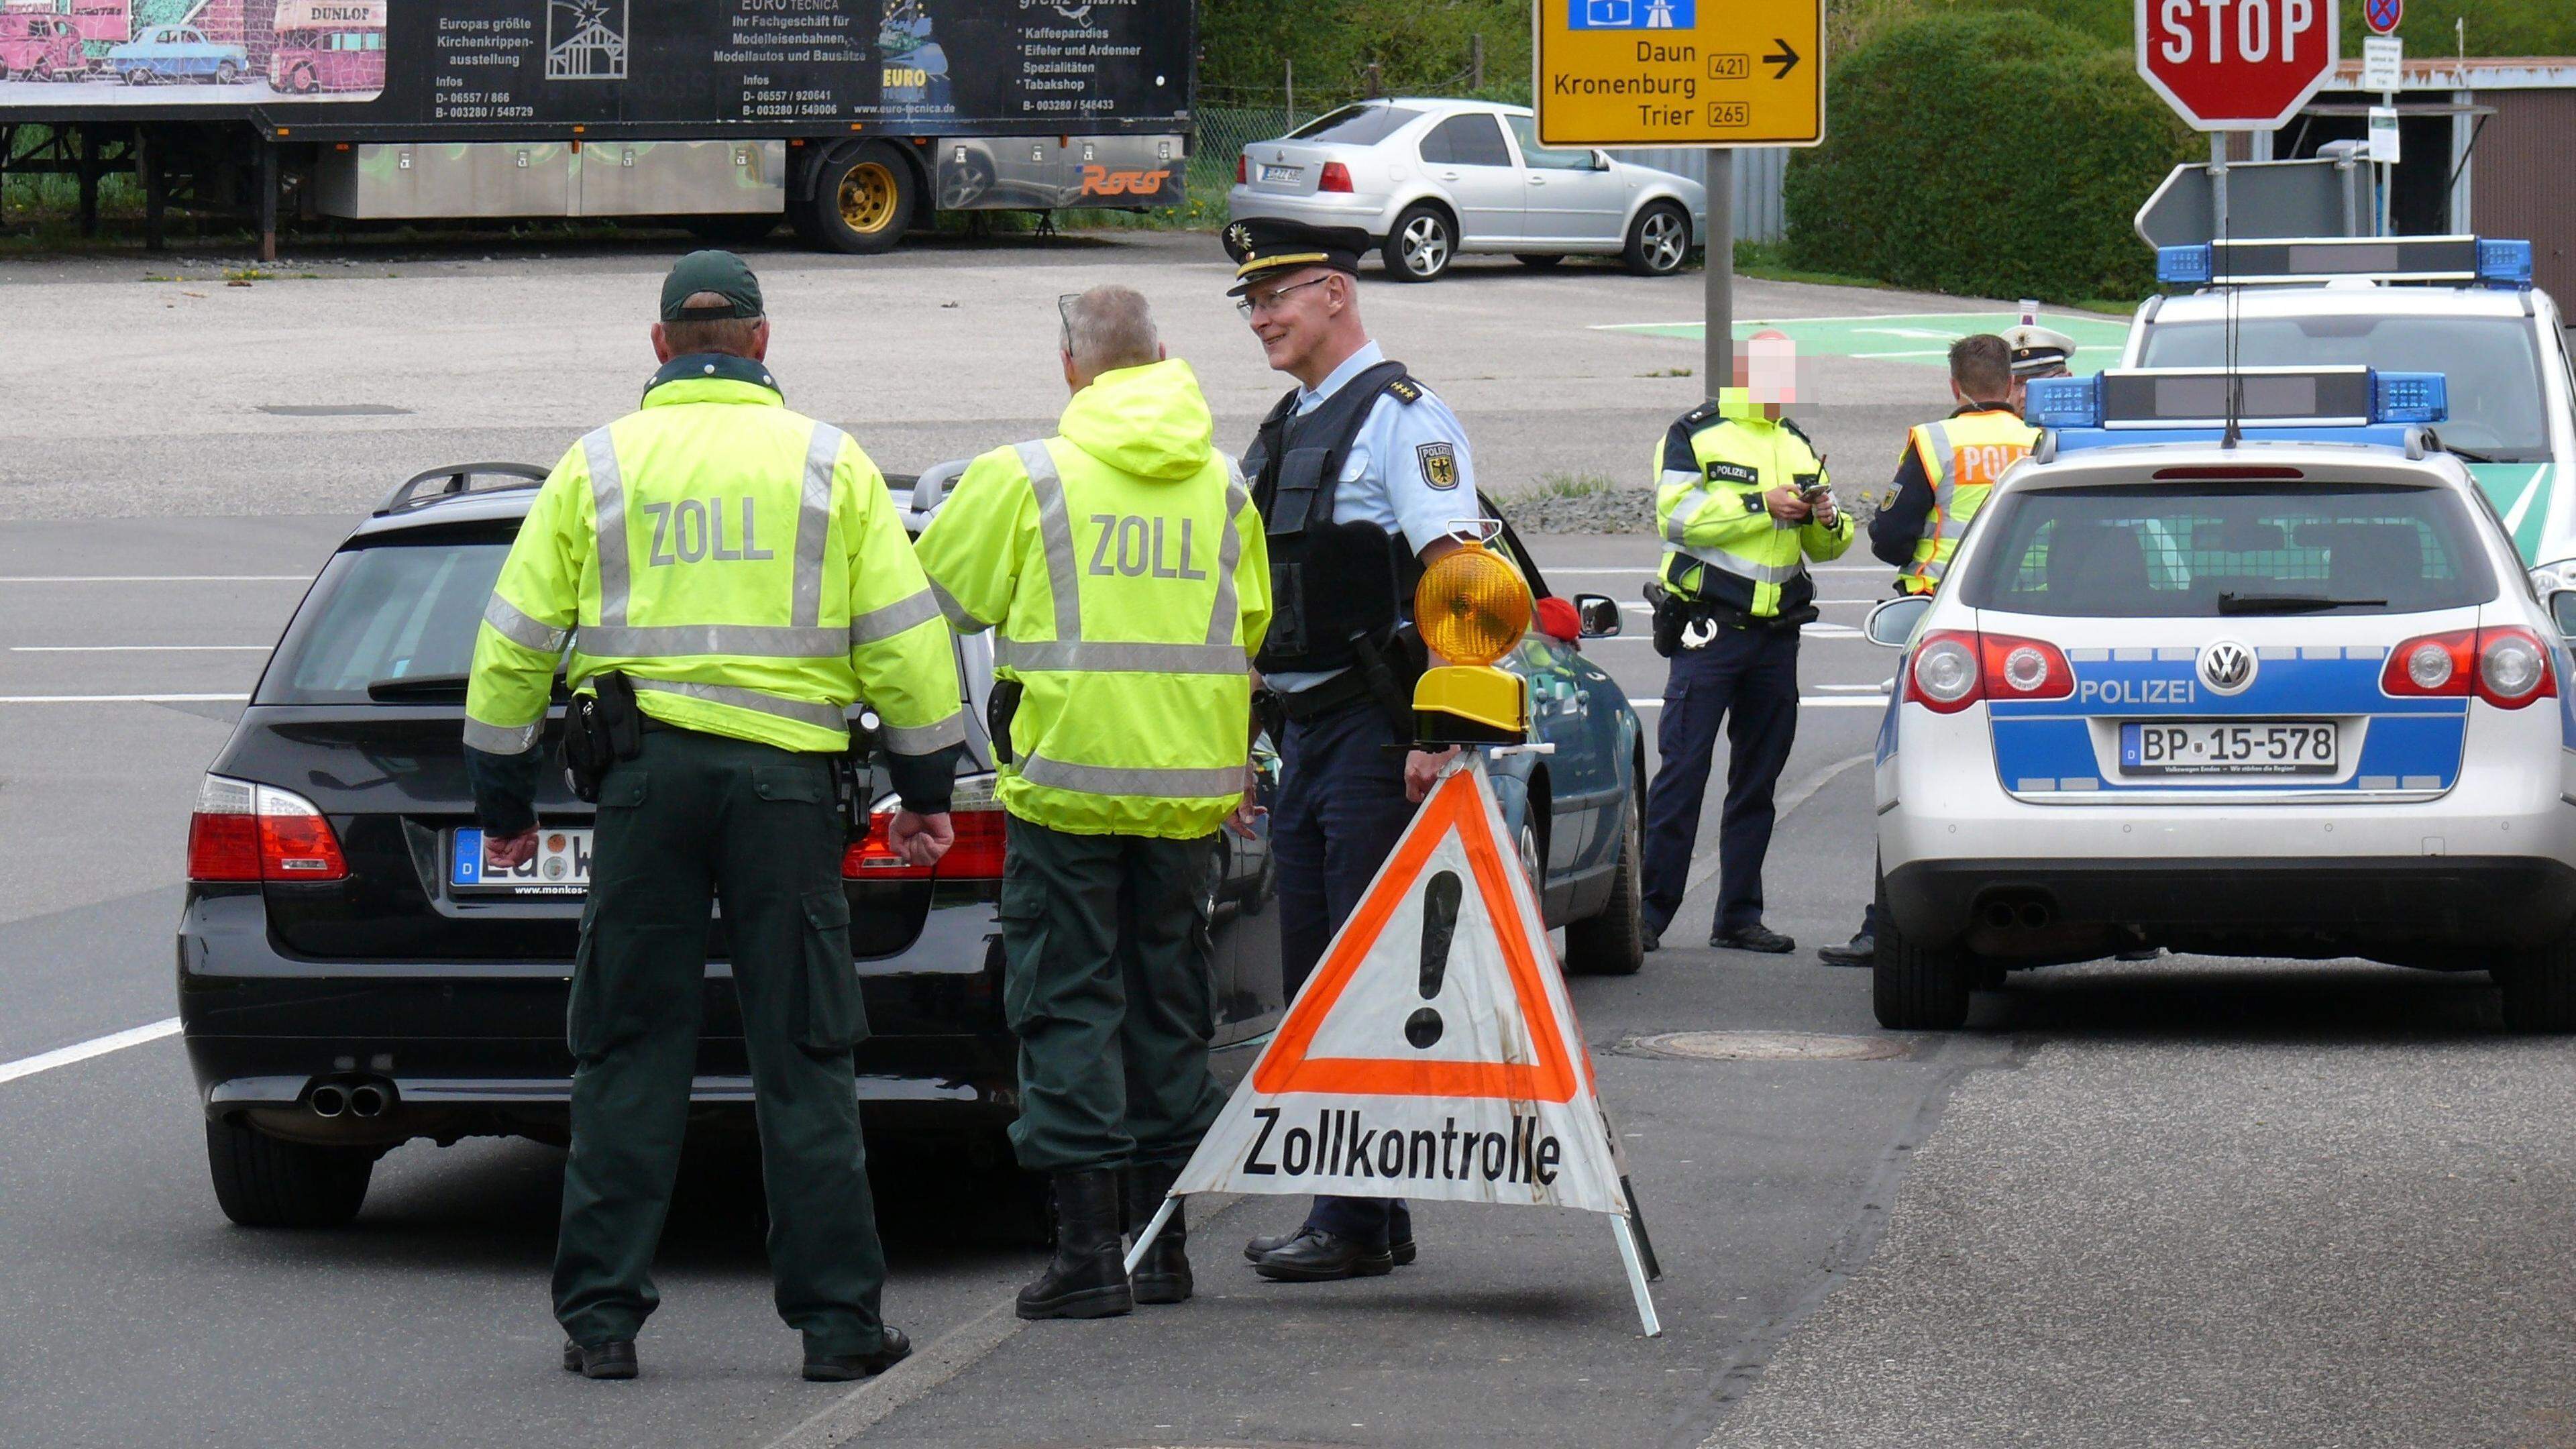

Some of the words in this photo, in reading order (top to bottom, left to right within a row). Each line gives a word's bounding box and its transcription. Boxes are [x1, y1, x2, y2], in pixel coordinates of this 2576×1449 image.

[311, 7, 370, 20] DUNLOP
[1607, 3, 1613, 19] 1
[439, 18, 489, 32] Europas
[492, 18, 531, 32] größte
[733, 15, 749, 27] Ihr
[752, 15, 829, 29] Fachgeschäft
[833, 15, 850, 27] für
[1025, 28, 1109, 41] Kaffeeparadies
[2161, 0, 2313, 64] STOP
[437, 36, 533, 50] Kirchenkrippen-
[714, 50, 784, 62] Modellautos
[788, 50, 810, 62] und
[813, 50, 865, 62] Bausätze
[1025, 44, 1061, 56] Eifeler
[1065, 45, 1086, 56] und
[1089, 44, 1141, 56] Ardenner
[1637, 41, 1695, 62] Daun
[449, 54, 519, 67] ausstellung
[1714, 59, 1743, 75] 421
[1023, 62, 1095, 75] Spezialitäten
[436, 76, 463, 87] Infos
[743, 74, 769, 85] Infos
[883, 68, 926, 87] EURO
[1024, 78, 1085, 92] Tabakshop
[1554, 73, 1696, 99] Kronenburg
[436, 93, 447, 103] D-
[451, 93, 482, 103] 06557
[491, 93, 510, 103] 866
[743, 91, 755, 101] D-
[757, 91, 787, 101] 06557
[436, 107, 447, 117] B-
[450, 107, 487, 117] 003280
[497, 107, 533, 117] 548729
[743, 105, 754, 115] B-
[757, 105, 792, 115] 003280
[854, 104, 955, 114] www.euro-tecnica.de
[1023, 101, 1034, 111] B-
[1036, 101, 1071, 111] 003280
[1638, 105, 1694, 125] Trier
[1713, 106, 1743, 123] 265
[1423, 446, 1450, 458] POLIZEI
[1717, 466, 1747, 478] POLIZEI
[643, 496, 774, 568] ZOLL
[1088, 515, 1206, 582] ZOLL
[2080, 680, 2195, 704] POLIZEI
[2128, 750, 2135, 759] D
[2144, 729, 2188, 760] BP
[2210, 728, 2332, 760] 15-578
[463, 863, 472, 875] D
[1243, 1108, 1560, 1186] Zollkontrolle
